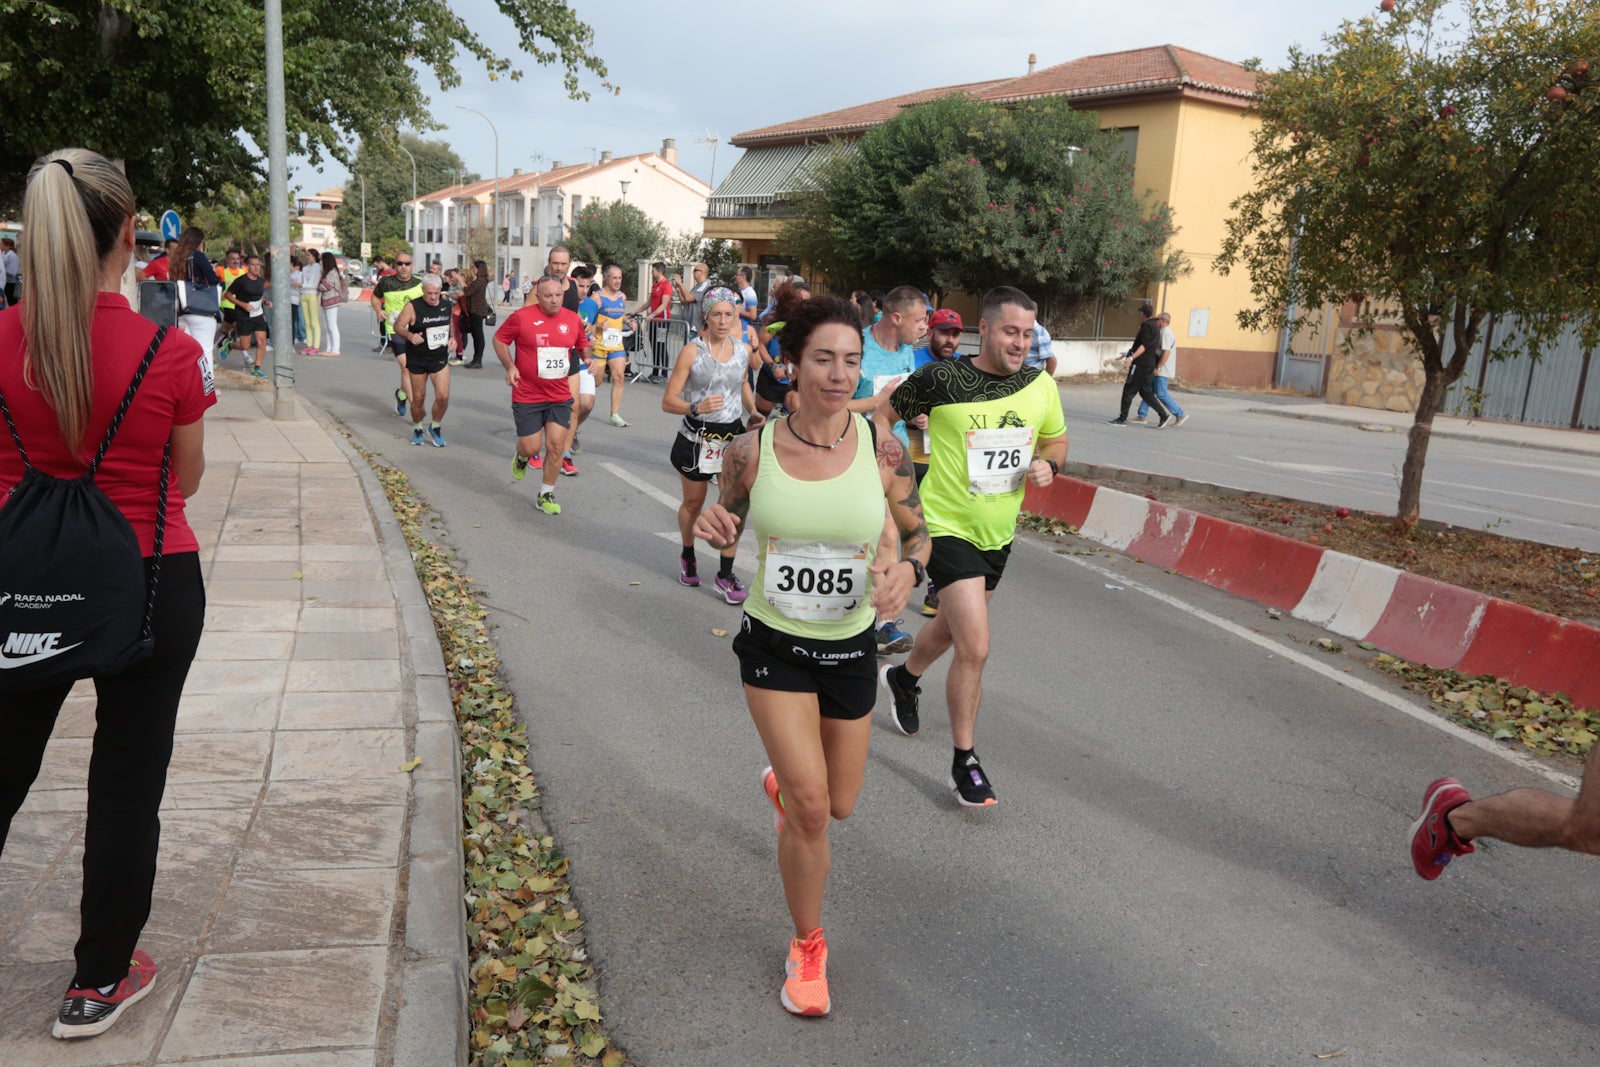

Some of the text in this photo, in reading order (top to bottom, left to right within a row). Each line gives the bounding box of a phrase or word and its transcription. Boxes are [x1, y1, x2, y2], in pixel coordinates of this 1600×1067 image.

[546, 359, 565, 369] 235
[968, 415, 987, 429] XI
[983, 449, 1021, 470] 726
[777, 565, 853, 595] 3085
[14, 593, 86, 602] RAFA NADAL
[3, 632, 63, 655] NIKE
[812, 650, 865, 660] LURBEL
